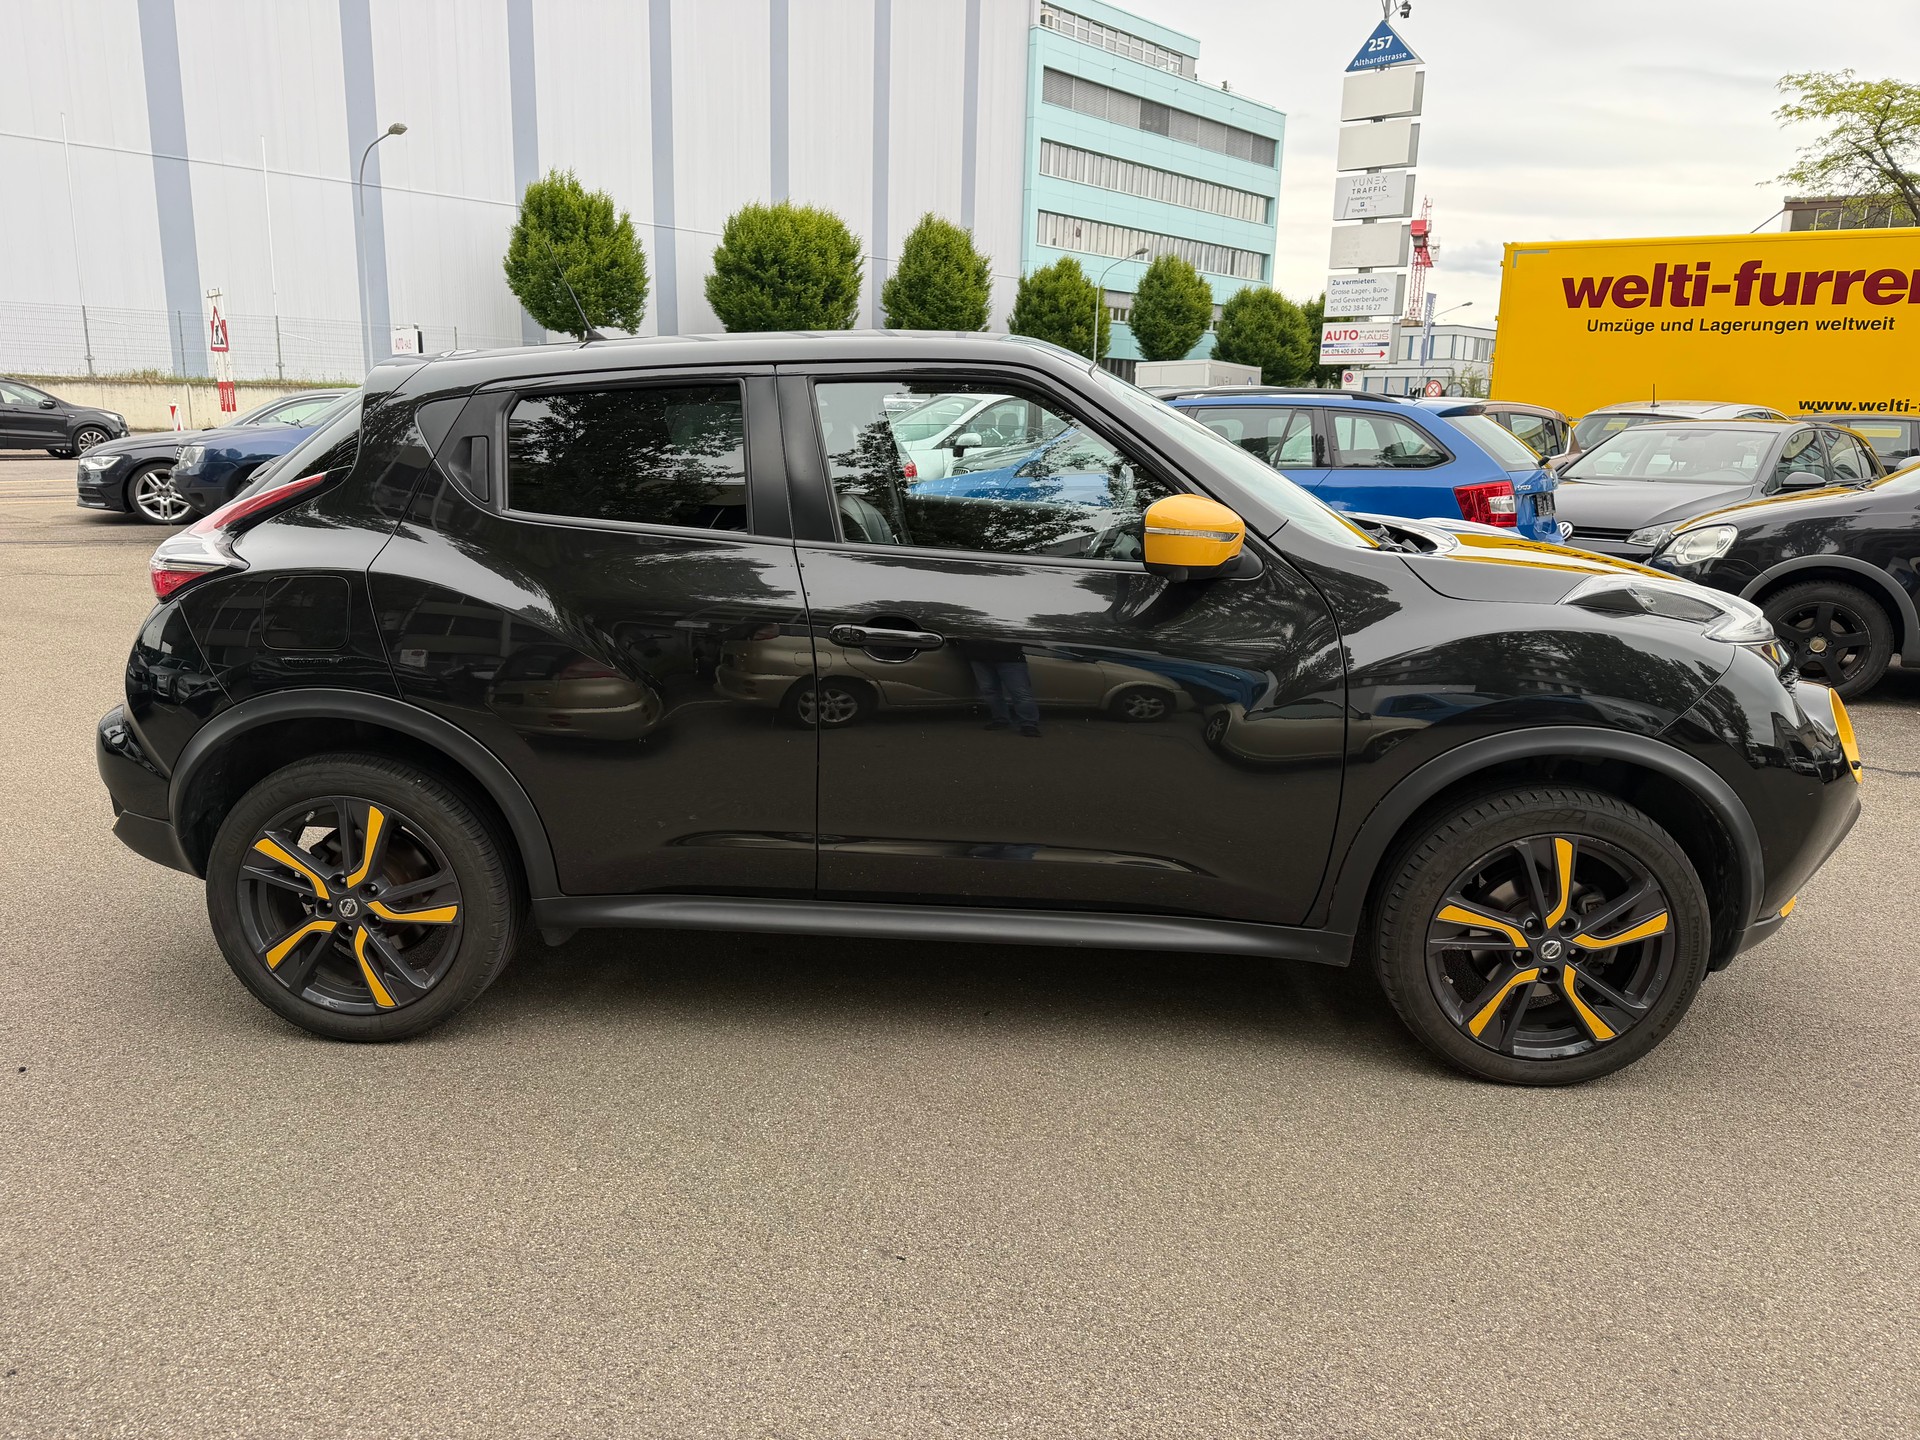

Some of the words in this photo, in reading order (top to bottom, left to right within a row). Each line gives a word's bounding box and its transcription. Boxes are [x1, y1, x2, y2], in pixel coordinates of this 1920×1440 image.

[1368, 35, 1393, 52] 257
[1354, 52, 1407, 67] Althardstrasse
[1352, 175, 1388, 187] YUNEX
[1352, 185, 1387, 195] TRAFFIC
[1343, 296, 1389, 304] Gewerberäume
[1587, 318, 1655, 335] Umzüge
[1660, 318, 1694, 332] und
[1699, 317, 1809, 335] Lagerungen
[1815, 316, 1896, 331] weltweit
[1324, 329, 1359, 341] AUTO
[1360, 333, 1389, 341] HAUS
[1798, 398, 1920, 412] www.welti-
[1591, 818, 1664, 862] Continental
